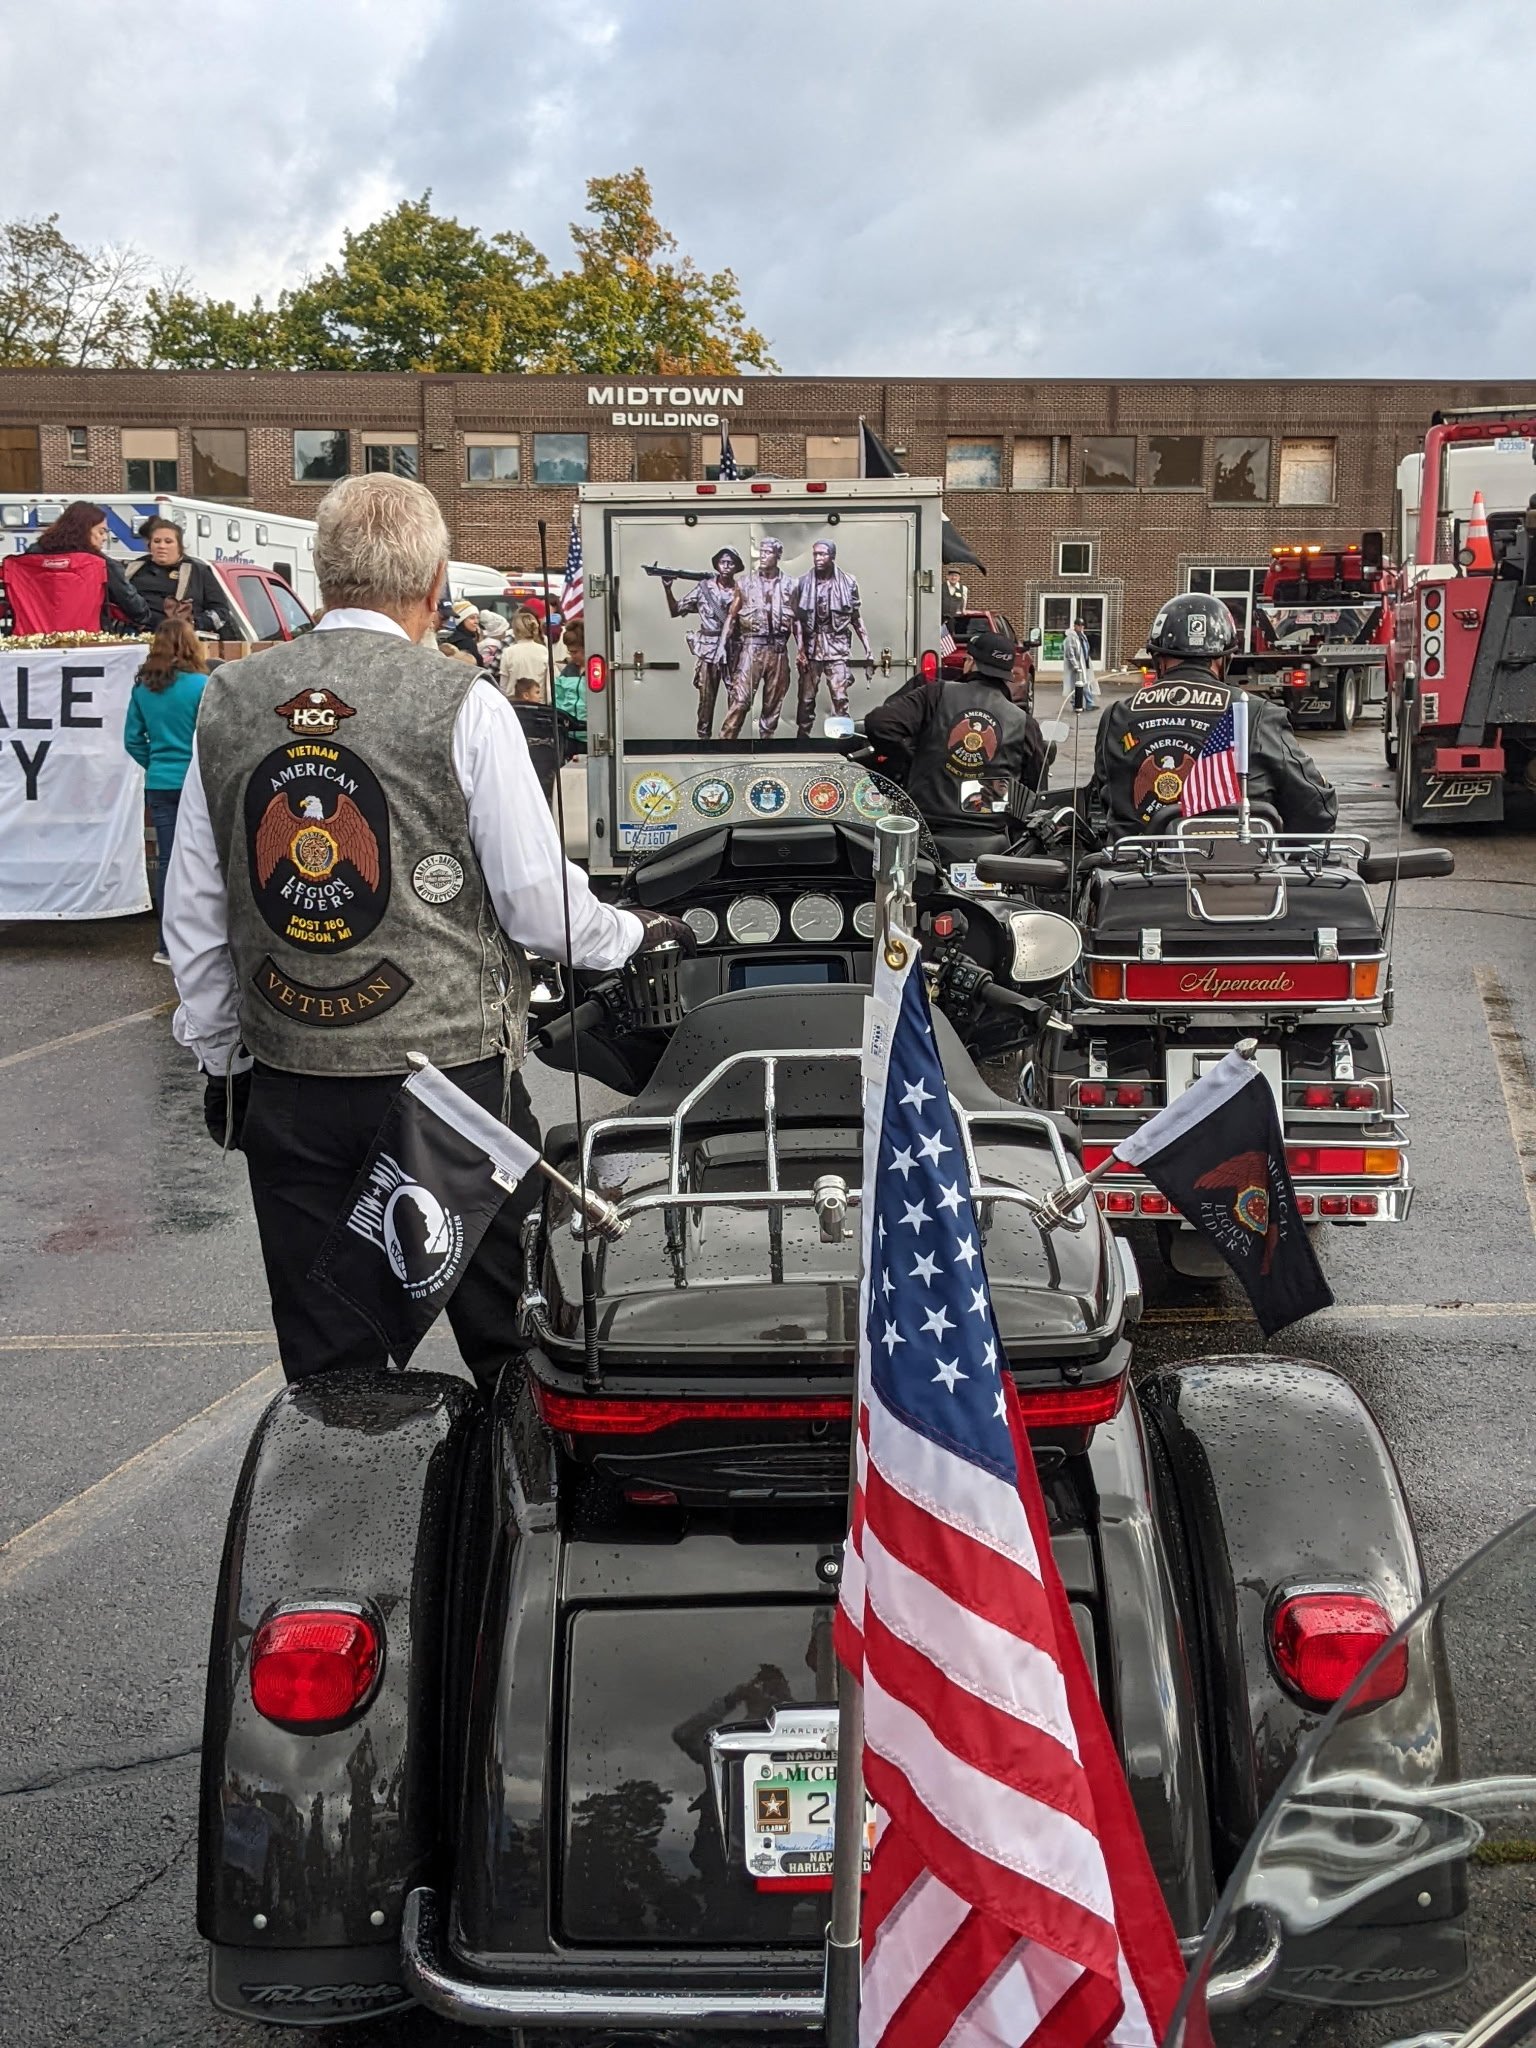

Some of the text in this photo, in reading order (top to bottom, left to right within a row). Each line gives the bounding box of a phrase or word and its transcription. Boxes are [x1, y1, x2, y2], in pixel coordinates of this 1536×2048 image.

[587, 386, 744, 406] MIDTOWN
[612, 412, 719, 427] BUILDING
[1135, 687, 1223, 706] POW MIA
[293, 708, 335, 726] HOG
[964, 711, 997, 727] AMERICAN
[1138, 717, 1210, 732] VIETNAM VET
[286, 745, 339, 761] VIETNAM
[1144, 738, 1196, 757] AMERICAN
[0, 740, 53, 801] Y
[270, 762, 359, 795] AMERICAN
[286, 875, 346, 899] LEGION
[280, 884, 355, 911] RIDERS
[291, 915, 345, 931] POST 180
[286, 925, 353, 943] HUDSON, MI
[1179, 967, 1296, 999] Aspencade
[267, 971, 392, 1018] VETERAN
[1267, 1154, 1289, 1241] MERICAN
[1200, 1202, 1249, 1257] RIDERS
[1215, 1204, 1254, 1247] LEGION
[411, 1288, 427, 1300] YOU
[429, 1280, 445, 1294] ARE
[442, 1263, 457, 1281] NOT
[786, 1766, 838, 1782] MICH
